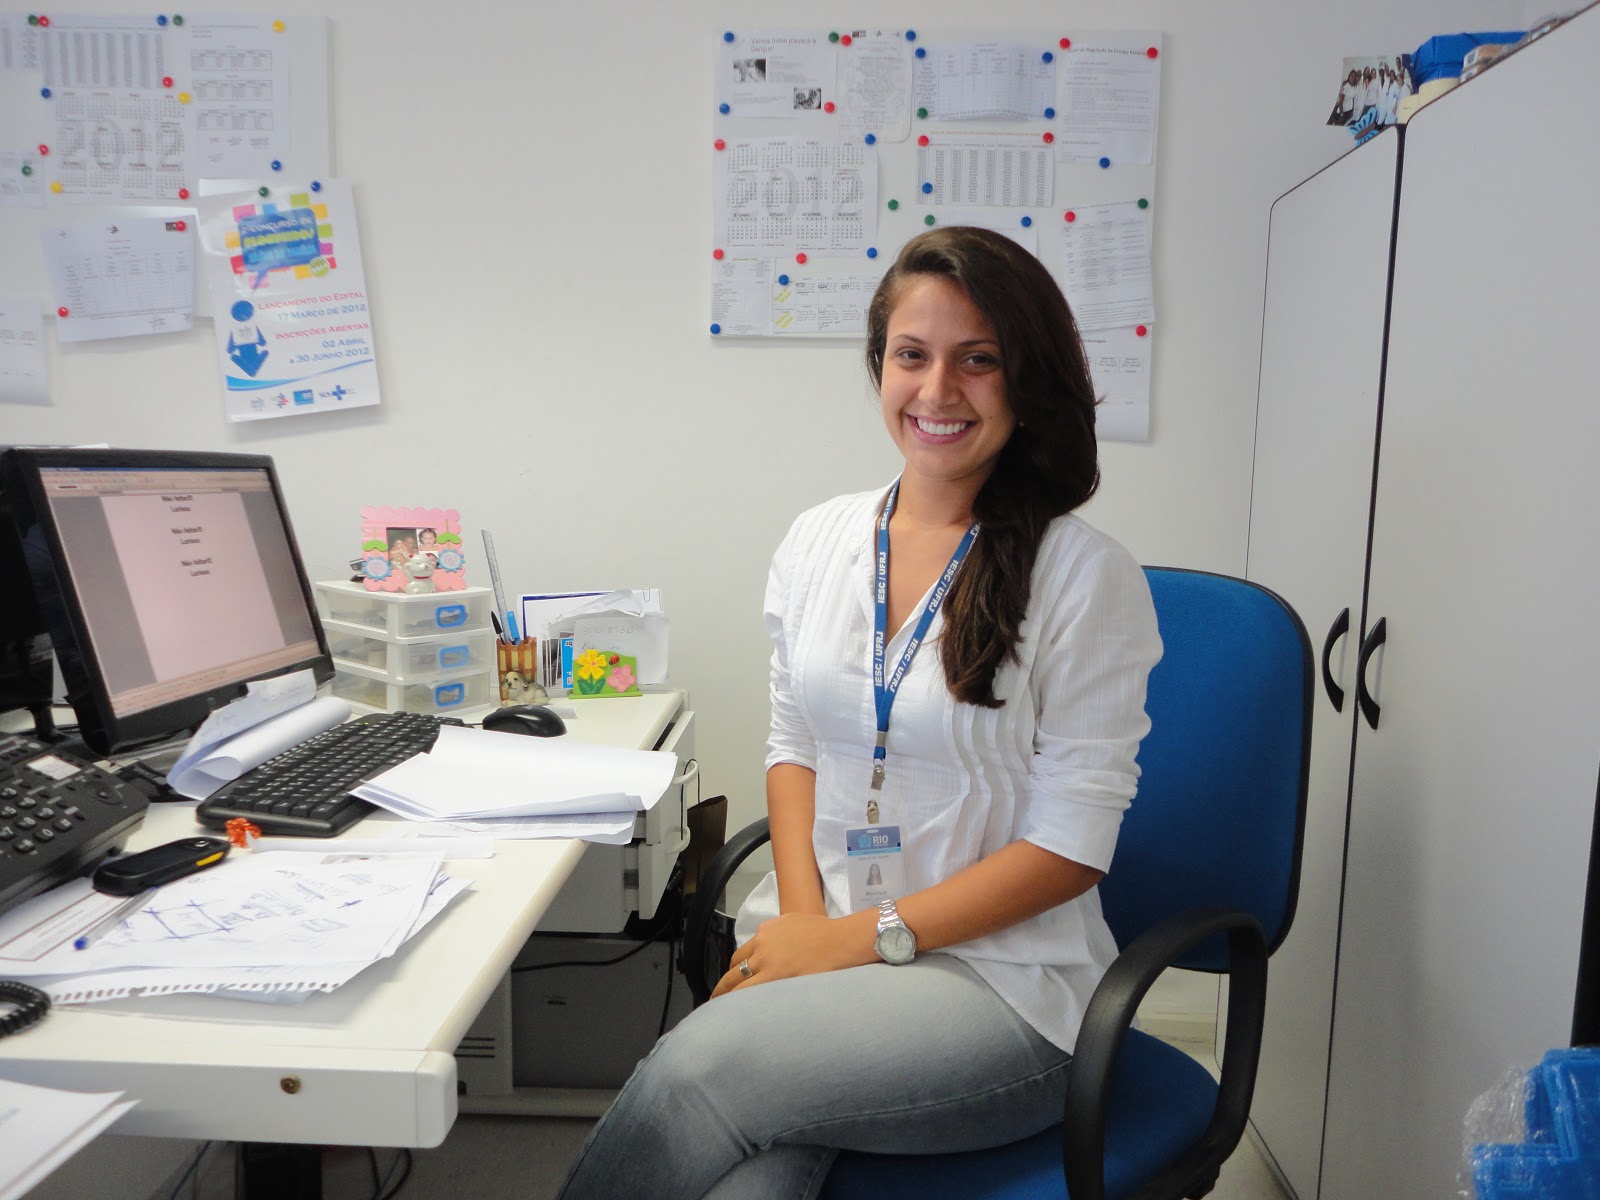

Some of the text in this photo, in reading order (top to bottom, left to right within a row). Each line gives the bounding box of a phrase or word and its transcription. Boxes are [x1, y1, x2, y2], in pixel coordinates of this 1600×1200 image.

[333, 291, 366, 302] EDITAL
[290, 309, 326, 319] MARÇO
[326, 307, 339, 315] DE
[341, 303, 367, 313] 2012
[328, 322, 369, 333] ABERTAS
[322, 337, 367, 348] 02 ABRIL
[296, 354, 310, 363] 30
[311, 351, 343, 362] JUNHO
[345, 347, 370, 357] 2012
[878, 551, 887, 576] UFRJ
[943, 559, 959, 583] IESC
[877, 581, 886, 604] IESC
[928, 586, 945, 613] UFRJ
[875, 631, 884, 657] UFRJ
[904, 638, 919, 661] IESC
[874, 663, 883, 687] IESC
[889, 667, 904, 693] UFRJ
[872, 834, 889, 844] RIO
